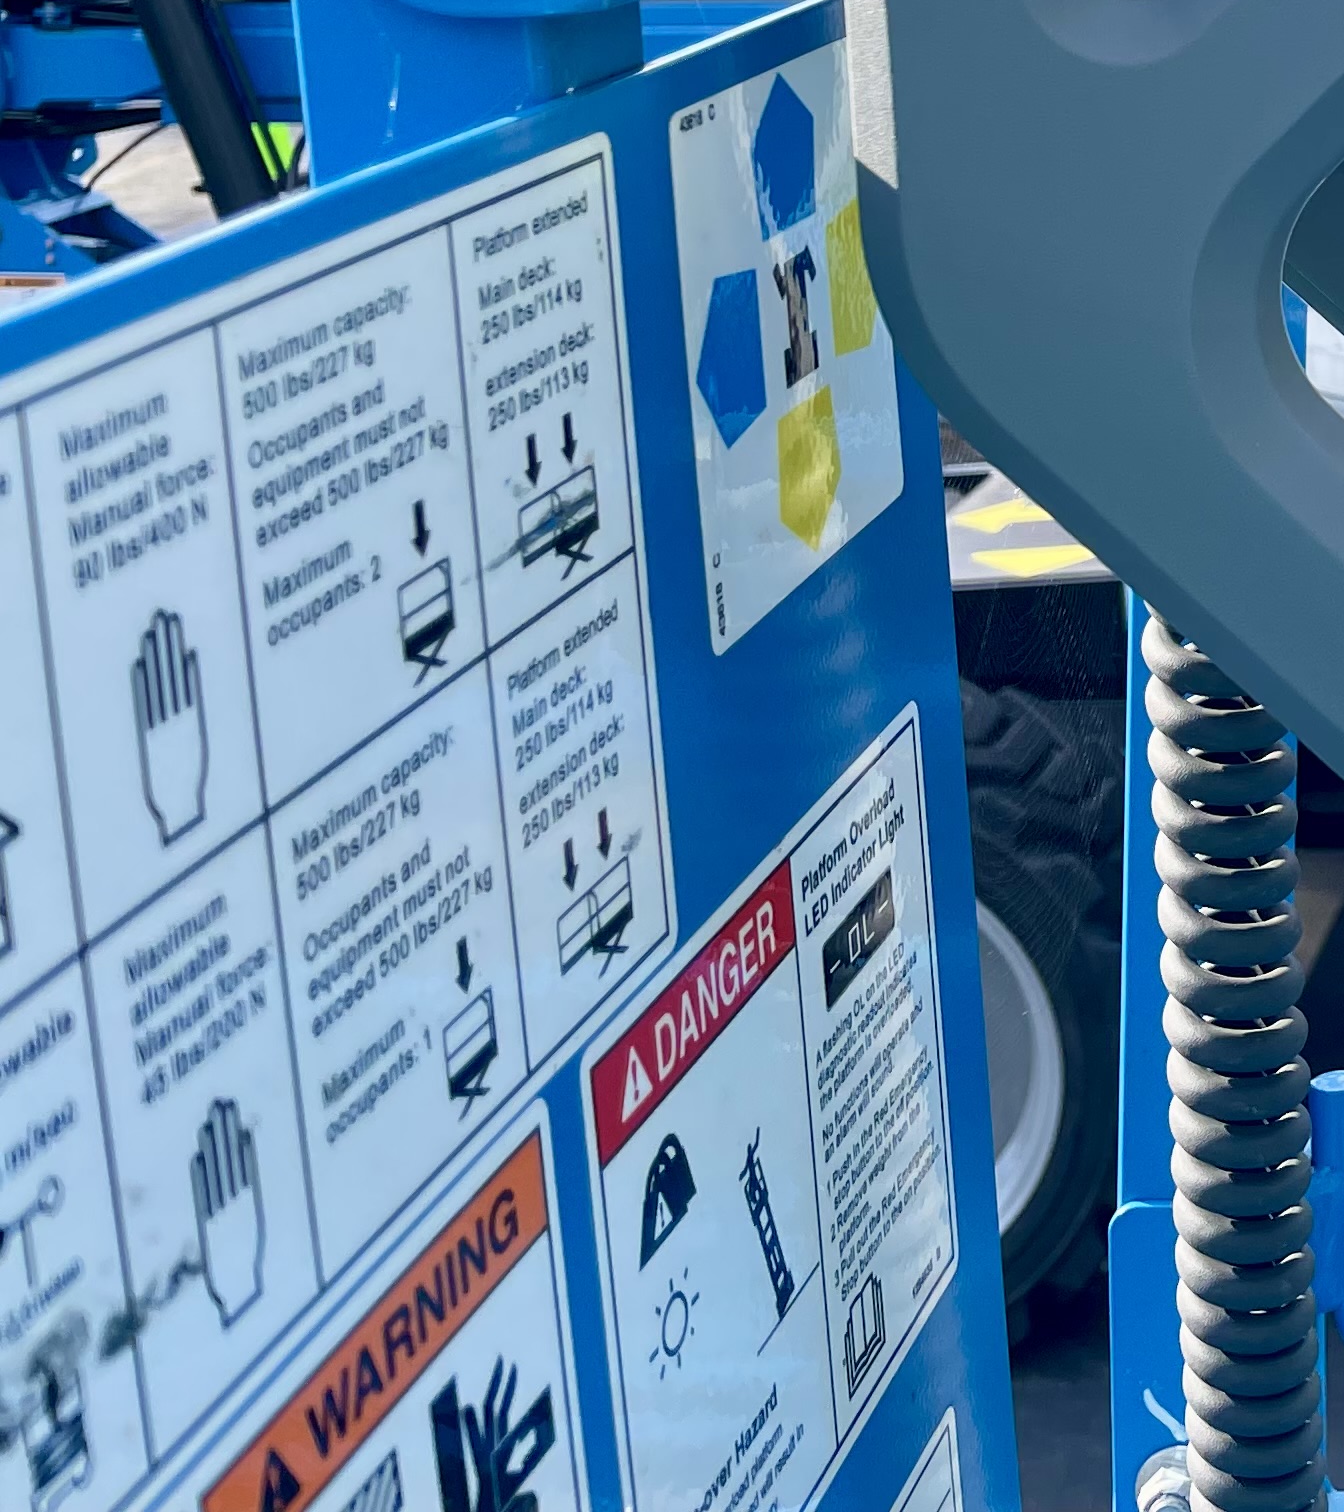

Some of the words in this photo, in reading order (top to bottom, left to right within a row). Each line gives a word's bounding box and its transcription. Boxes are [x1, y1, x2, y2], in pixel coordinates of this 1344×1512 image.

[473, 223, 530, 263] Platform
[532, 190, 588, 236] extended
[478, 277, 516, 310] Main
[517, 256, 556, 290] deck:
[481, 311, 509, 345] 250
[512, 283, 563, 328] lbs/114
[565, 278, 582, 303] kg
[238, 323, 328, 381] Maximum
[334, 285, 411, 336] capacity:
[243, 380, 277, 419] 500
[282, 345, 349, 401] lbs/227
[353, 339, 376, 367] kg
[486, 345, 556, 398] extension
[558, 322, 595, 358] deck:
[59, 393, 168, 460] Maximum
[248, 402, 347, 469] Occupants
[352, 377, 385, 416] and
[488, 396, 517, 432] 250
[519, 367, 570, 414] lbs/113
[572, 360, 589, 385] kg
[65, 434, 170, 505] allowable
[252, 438, 350, 509] equipment
[354, 411, 397, 454] must
[399, 394, 425, 428] not
[256, 488, 323, 548] exceed
[327, 468, 359, 506] 500
[364, 430, 424, 486] lbs/227
[428, 420, 448, 450] kg
[191, 493, 208, 525] N
[263, 540, 353, 608] Maximum
[370, 554, 381, 582] 2
[507, 647, 560, 701] Platform
[563, 598, 618, 656] extended
[512, 697, 548, 738] Main
[551, 665, 587, 708] deck:
[515, 731, 543, 772] 250
[544, 689, 594, 748] lbs/114
[597, 679, 613, 705] kg
[291, 784, 377, 865] Maximum
[380, 725, 455, 795] capacity:
[519, 745, 587, 816] extension
[589, 713, 625, 756] deck:
[521, 809, 549, 850] 250
[551, 764, 600, 824] lbs/113
[603, 751, 619, 778] kg
[297, 855, 331, 900] 500
[334, 800, 396, 873] lbs/227
[401, 789, 421, 819] kg
[801, 837, 848, 902] Platform
[850, 778, 895, 845] Overload
[804, 893, 829, 937] LED
[831, 839, 876, 906] Indicator
[879, 804, 904, 849] Light
[123, 894, 228, 987] Maximum
[303, 873, 397, 962] Occupants
[401, 837, 431, 883] and
[307, 904, 400, 1001] equipment
[402, 869, 442, 921] must
[445, 845, 470, 885] not
[129, 934, 231, 1026] allowable
[312, 960, 377, 1039] exceed
[379, 933, 410, 978] 500
[413, 878, 470, 950] lbs/227
[474, 864, 493, 895] kg
[654, 900, 776, 1082] DANGER
[423, 1025, 432, 1050] 1
[816, 1048, 823, 1070] A
[823, 1011, 852, 1059] flashing
[853, 993, 865, 1018] OL
[866, 982, 876, 1002] on
[876, 966, 888, 991] the
[888, 942, 904, 973] LED
[818, 1030, 857, 1091] diagnostic
[857, 989, 886, 1037] readout
[321, 1018, 406, 1109] Maximum
[820, 1087, 832, 1112] the
[834, 1044, 865, 1098] platform
[865, 1033, 872, 1051] is
[822, 1122, 834, 1146] No
[835, 1073, 869, 1128] functions
[869, 1052, 882, 1079] will
[882, 1018, 909, 1061] operate
[910, 995, 923, 1025] and
[825, 1142, 835, 1163] an
[836, 1111, 857, 1148] alarm
[858, 1087, 870, 1116] will
[832, 1153, 852, 1188] Push
[853, 1141, 861, 1160] in
[861, 1123, 873, 1148] the
[874, 1098, 888, 1129] Red
[889, 1045, 928, 1107] Emergency
[834, 1179, 850, 1210] stop
[851, 1144, 874, 1185] button
[875, 1132, 883, 1149] to
[883, 1113, 895, 1138] the
[830, 1224, 836, 1243] 2
[837, 1180, 868, 1232] Remove
[868, 1142, 892, 1185] weight
[892, 1120, 908, 1150] from
[908, 1102, 920, 1125] the
[840, 1241, 855, 1276] Pull
[857, 1225, 869, 1254] out
[869, 1210, 881, 1234] the
[881, 1182, 896, 1215] Red
[897, 1127, 935, 1192] Emergency
[839, 1201, 871, 1257] platform.
[841, 1269, 858, 1301] Stop
[859, 1232, 883, 1275] button
[883, 1219, 891, 1237] to
[891, 1201, 903, 1225] the
[904, 1186, 913, 1206] on
[305, 1188, 519, 1459] WARNING
[734, 1382, 777, 1465] Hazard
[751, 1423, 782, 1484] platform
[761, 1468, 773, 1499] will
[775, 1434, 795, 1479] result
[796, 1424, 804, 1441] in
